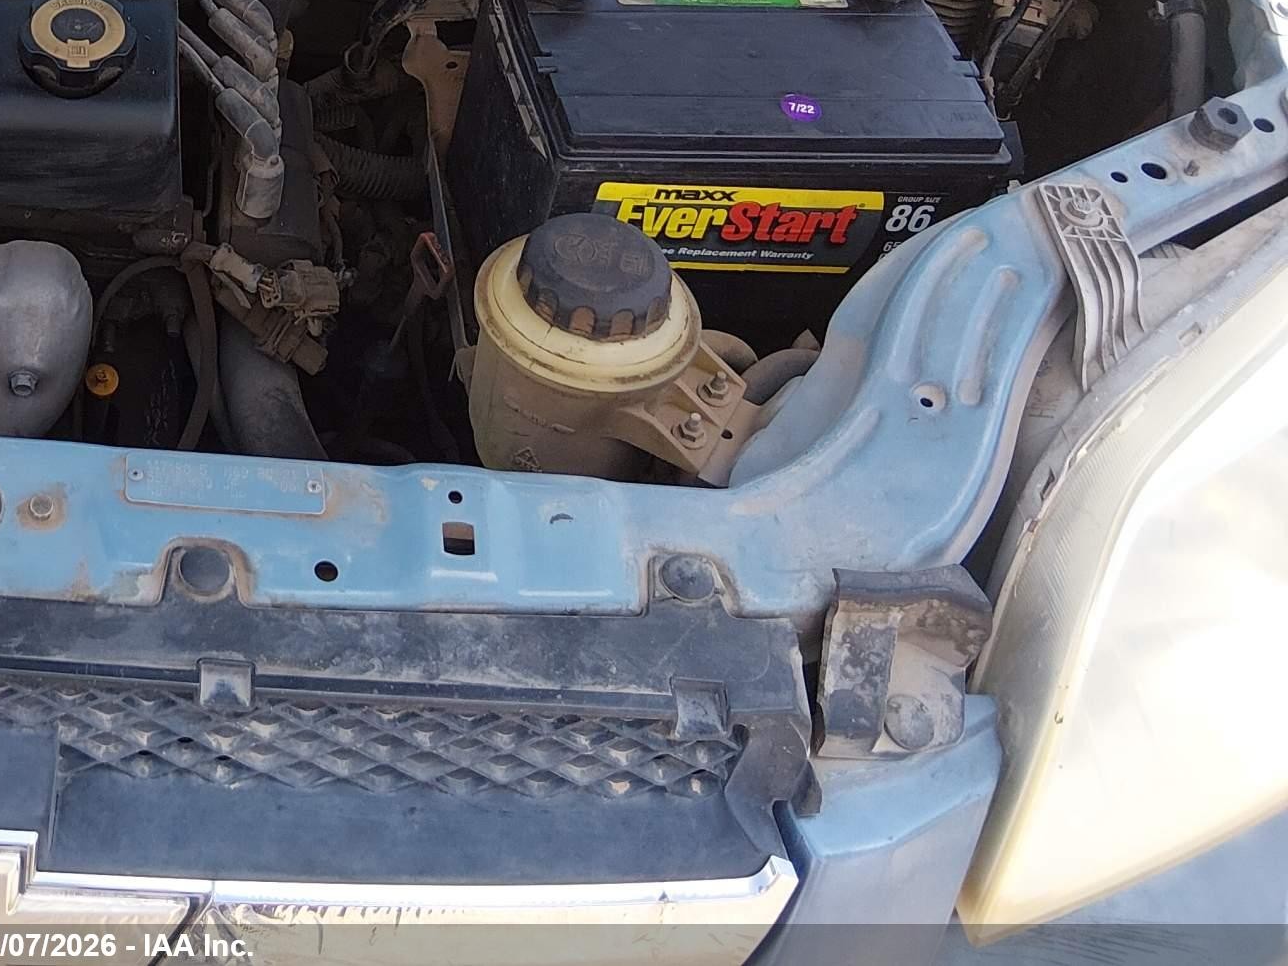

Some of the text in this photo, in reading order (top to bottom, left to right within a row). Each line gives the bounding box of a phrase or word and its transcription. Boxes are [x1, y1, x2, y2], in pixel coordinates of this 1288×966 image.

[788, 102, 815, 114] 7/22
[655, 188, 739, 202] maxx
[924, 196, 942, 204] SIZE
[616, 198, 857, 244] EverStart
[885, 204, 935, 233] 86
[677, 247, 757, 258] Replacement
[760, 249, 815, 260] Warranty
